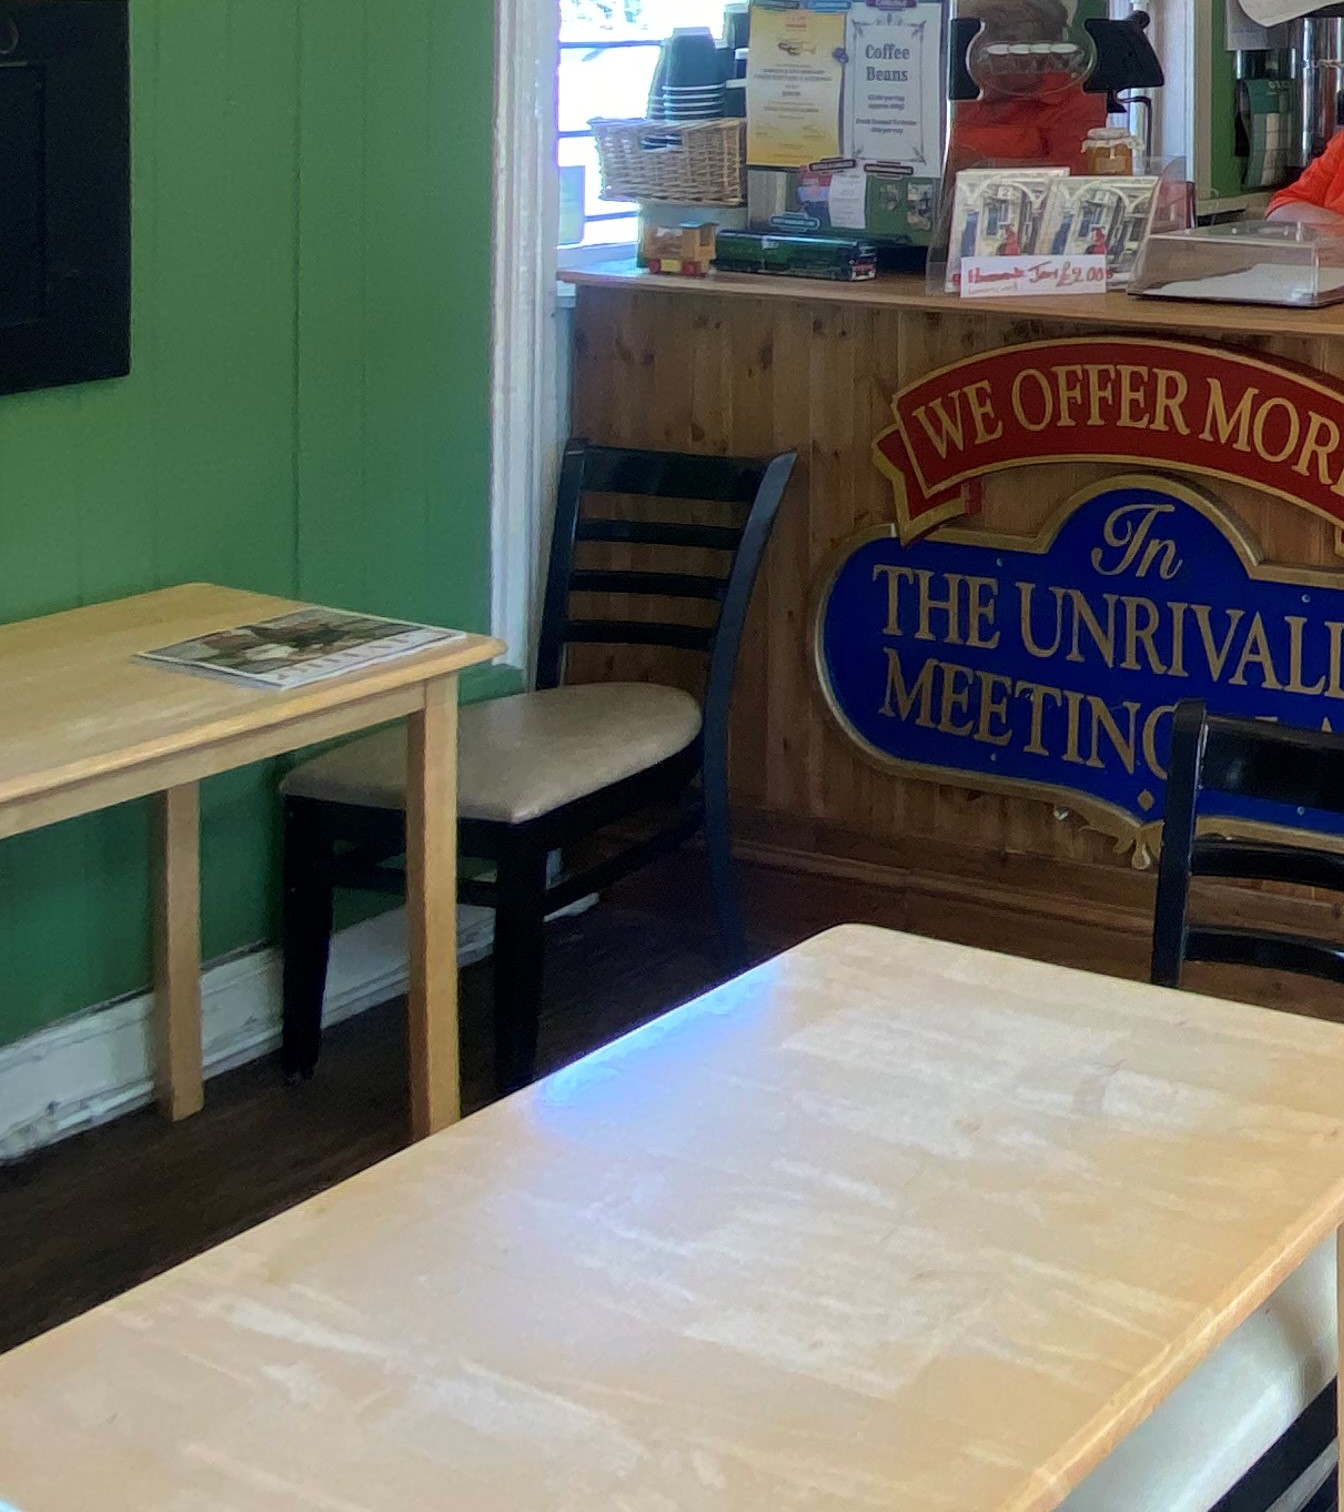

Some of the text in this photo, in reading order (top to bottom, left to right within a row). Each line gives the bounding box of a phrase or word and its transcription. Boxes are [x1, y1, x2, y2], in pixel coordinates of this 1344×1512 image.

[865, 44, 910, 60] Coffee
[866, 66, 909, 82] Beans
[912, 379, 1003, 460] WE
[1011, 364, 1190, 436] OFFER
[1090, 503, 1184, 581] In
[873, 564, 1000, 650] THE
